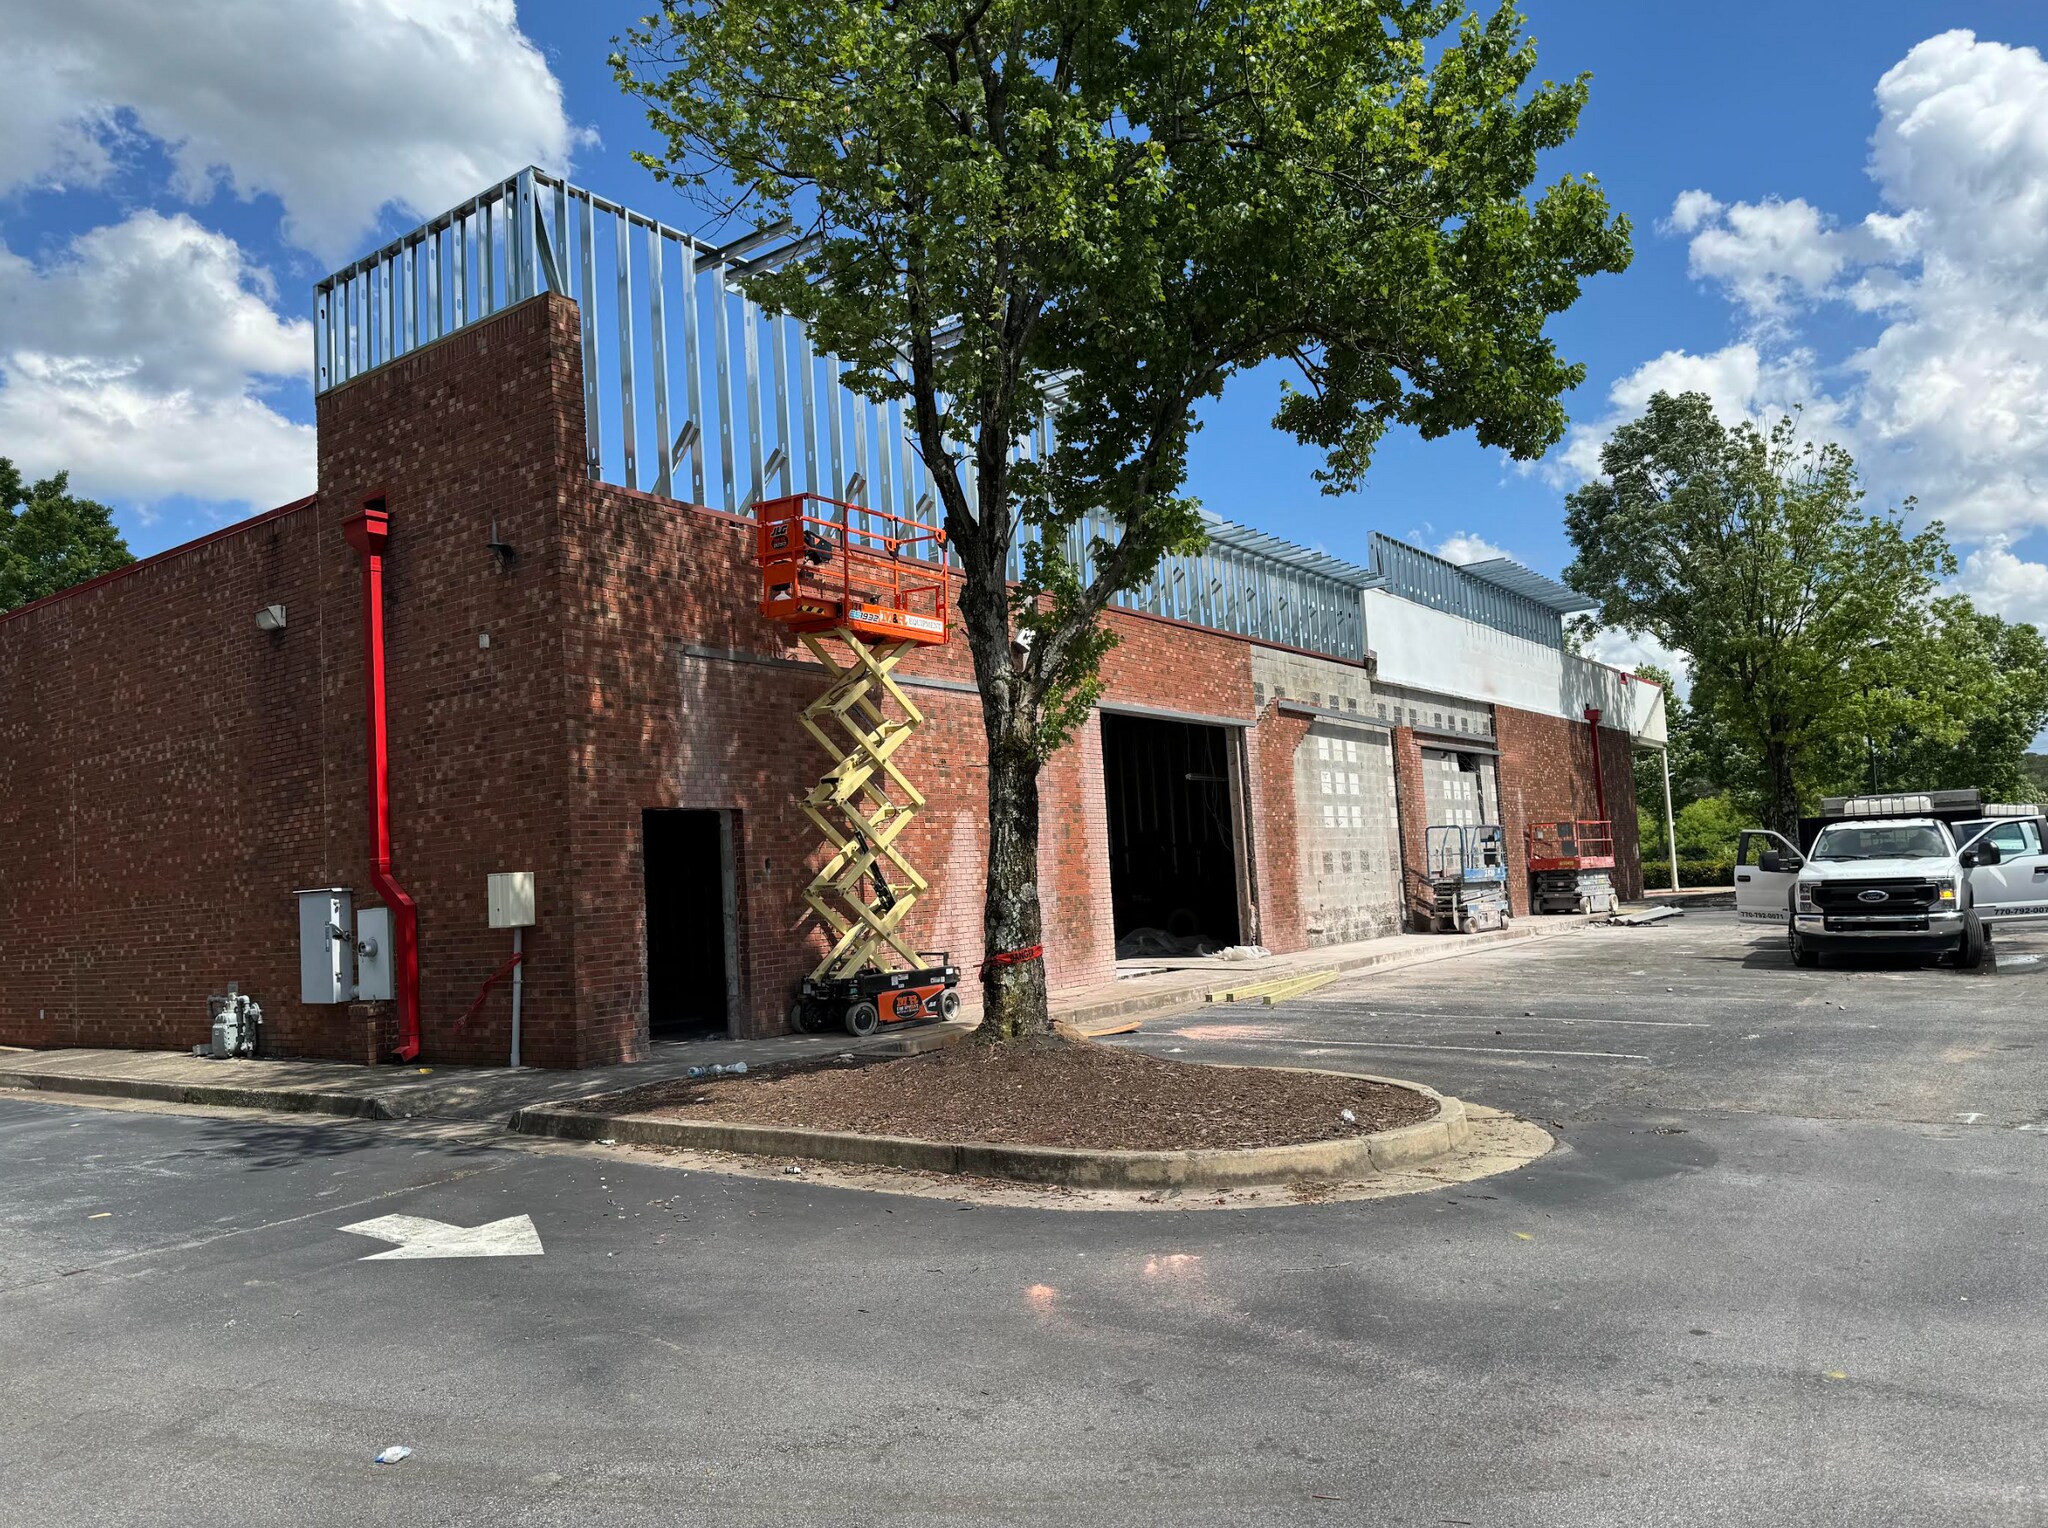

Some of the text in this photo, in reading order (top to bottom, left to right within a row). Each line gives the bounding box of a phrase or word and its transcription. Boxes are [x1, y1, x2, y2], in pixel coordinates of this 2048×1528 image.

[771, 525, 788, 537] JLG
[880, 610, 941, 630] M&R EQUIPMENT
